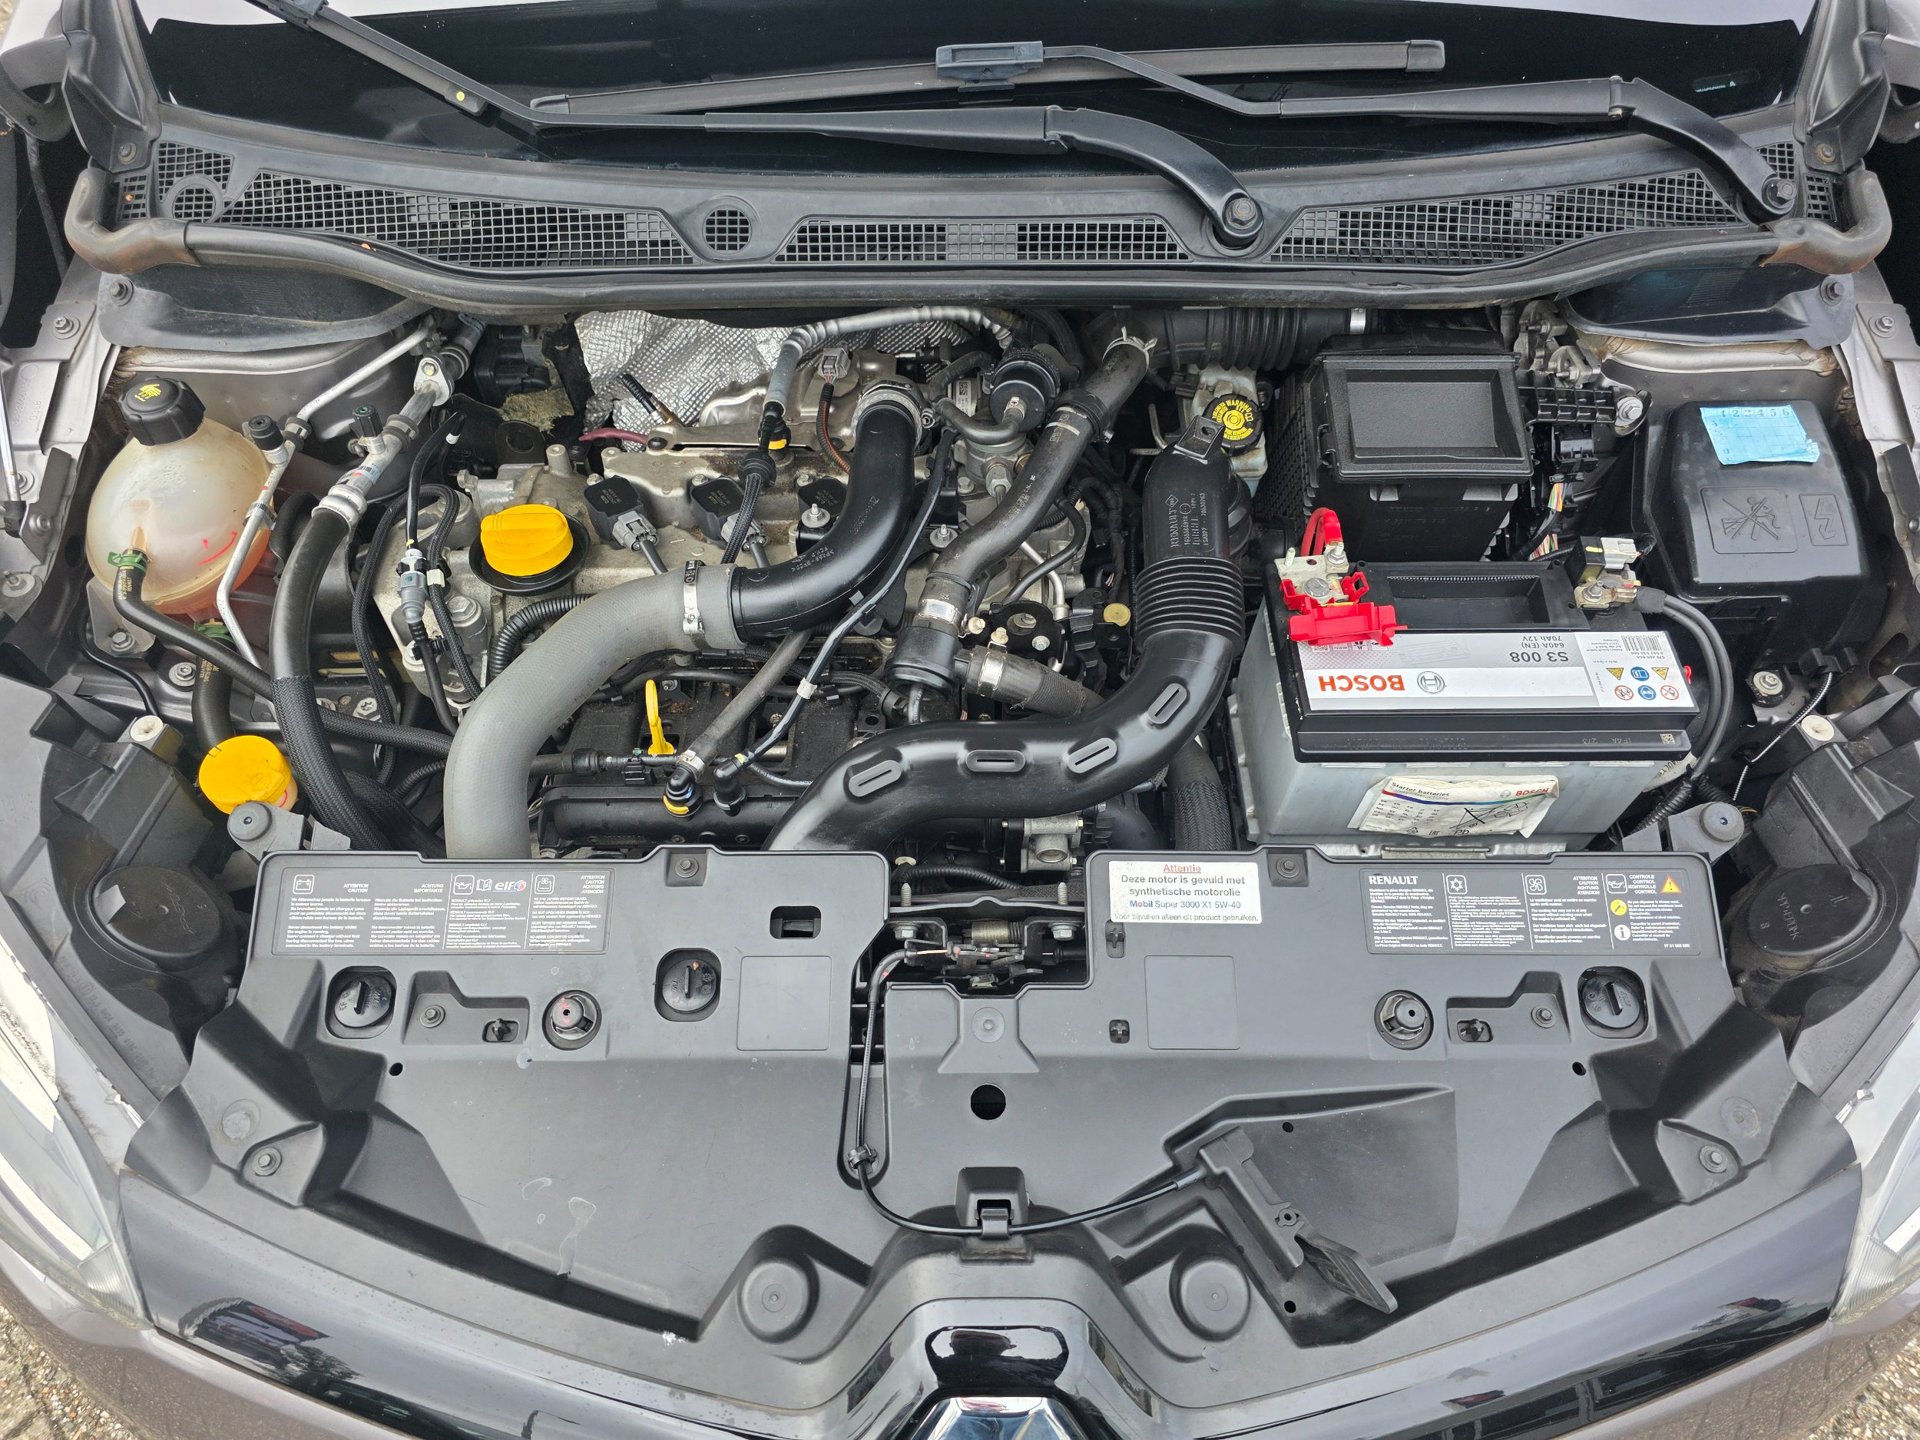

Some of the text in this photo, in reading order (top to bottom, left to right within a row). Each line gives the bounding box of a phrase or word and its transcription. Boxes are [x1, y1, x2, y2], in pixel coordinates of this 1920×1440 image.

[1720, 407, 1790, 418] 1 2 3 4 5 6
[1509, 651, 1569, 662] S3 008
[1318, 675, 1405, 692] BOSCH
[1515, 787, 1550, 797] BOSCH
[1163, 864, 1201, 874] Attentie
[1121, 875, 1146, 883] Deze
[1148, 876, 1178, 884] motor
[1180, 875, 1189, 884] is
[1191, 876, 1223, 886] gevuld
[1368, 876, 1418, 885] RENAULT
[494, 881, 515, 891] elf
[1129, 887, 1241, 897] synthetische motorolie
[1130, 900, 1153, 908] Mobil
[1154, 900, 1178, 909] Super
[1202, 901, 1212, 909] X1
[1214, 901, 1242, 909] 5W-40
